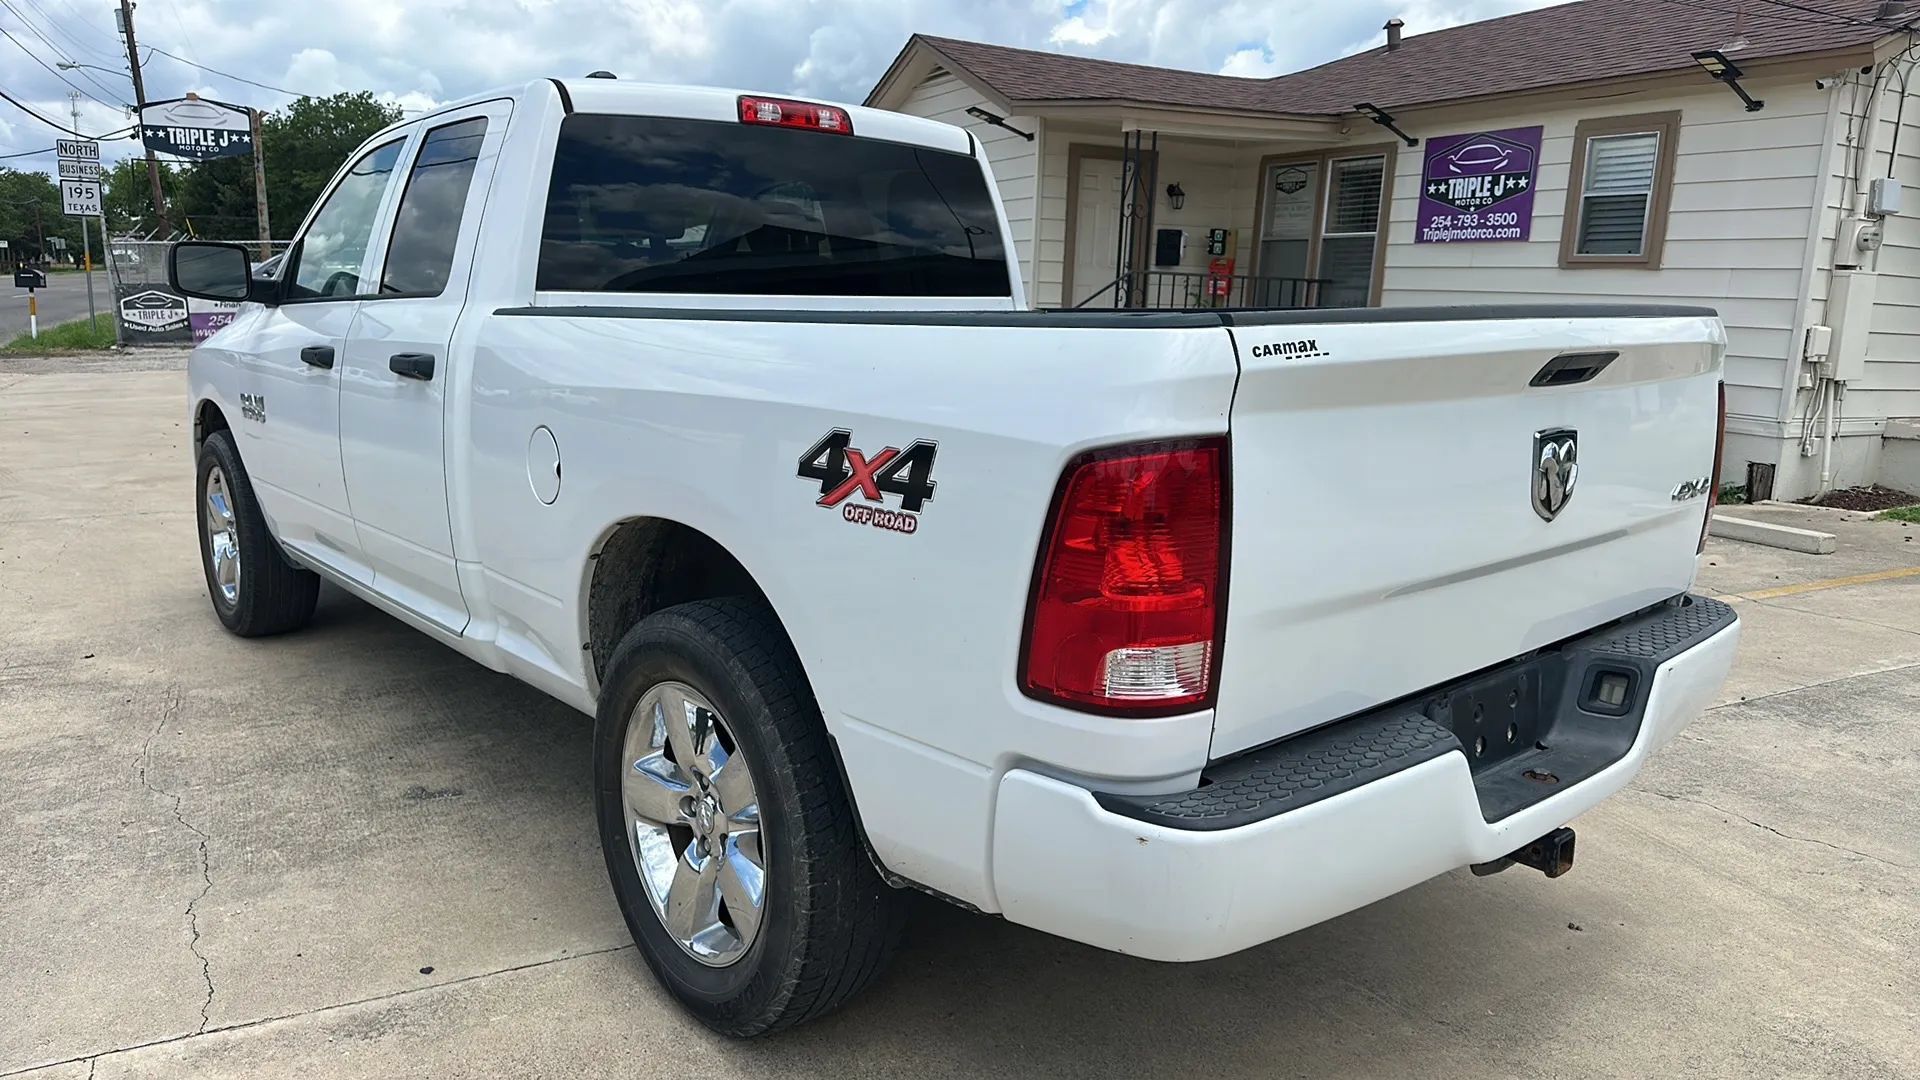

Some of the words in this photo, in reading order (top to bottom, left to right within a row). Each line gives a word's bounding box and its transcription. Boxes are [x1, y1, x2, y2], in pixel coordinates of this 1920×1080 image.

[167, 127, 217, 147] TRIPLE
[219, 130, 229, 148] J
[59, 142, 97, 158] NORTH
[179, 144, 207, 152] MOTOR
[60, 163, 99, 176] BUSINESS
[68, 186, 95, 200] 195
[1448, 175, 1492, 199] TRIPLE
[1494, 175, 1506, 197] J
[68, 203, 98, 213] TEXAS
[1455, 198, 1480, 207] MOTOR
[1482, 197, 1493, 205] CO
[1423, 227, 1521, 242] Triplejmotorco.com
[138, 310, 165, 320] TRIPLE
[168, 310, 173, 320] J
[208, 315, 232, 326] 254
[129, 322, 147, 332] Used
[165, 321, 184, 332] Sales
[843, 503, 873, 525] OFF
[872, 507, 918, 534] ROAD
